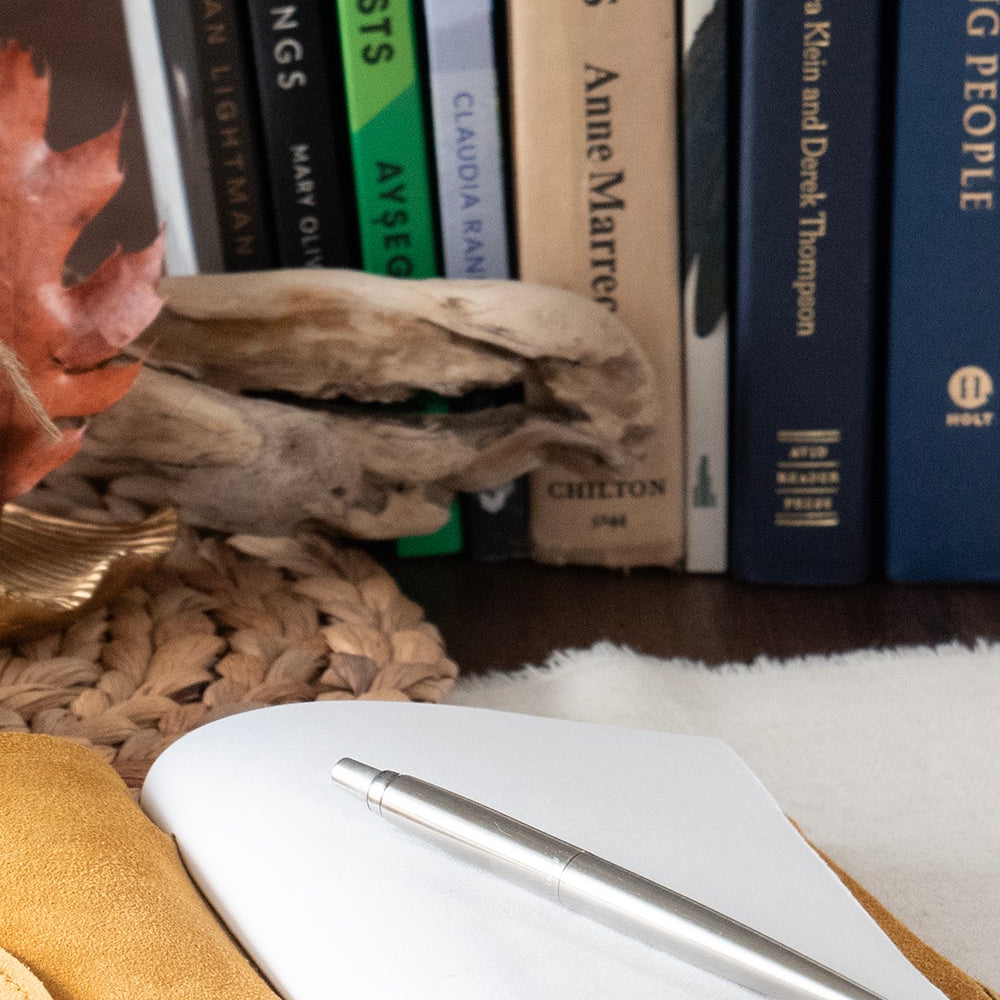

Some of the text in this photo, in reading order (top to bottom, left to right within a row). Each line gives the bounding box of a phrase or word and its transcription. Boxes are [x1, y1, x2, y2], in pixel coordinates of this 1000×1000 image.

[803, 20, 832, 82] Klein
[452, 92, 482, 210] CLAUDIA
[584, 61, 619, 160] Anne
[801, 87, 828, 132] and
[959, 52, 1000, 210] PEOPLE
[211, 63, 255, 257] LIGHTMAN
[289, 143, 317, 207] MARY
[799, 135, 829, 208] Derek
[793, 209, 828, 337] Thompson
[547, 477, 667, 500] CHILTON
